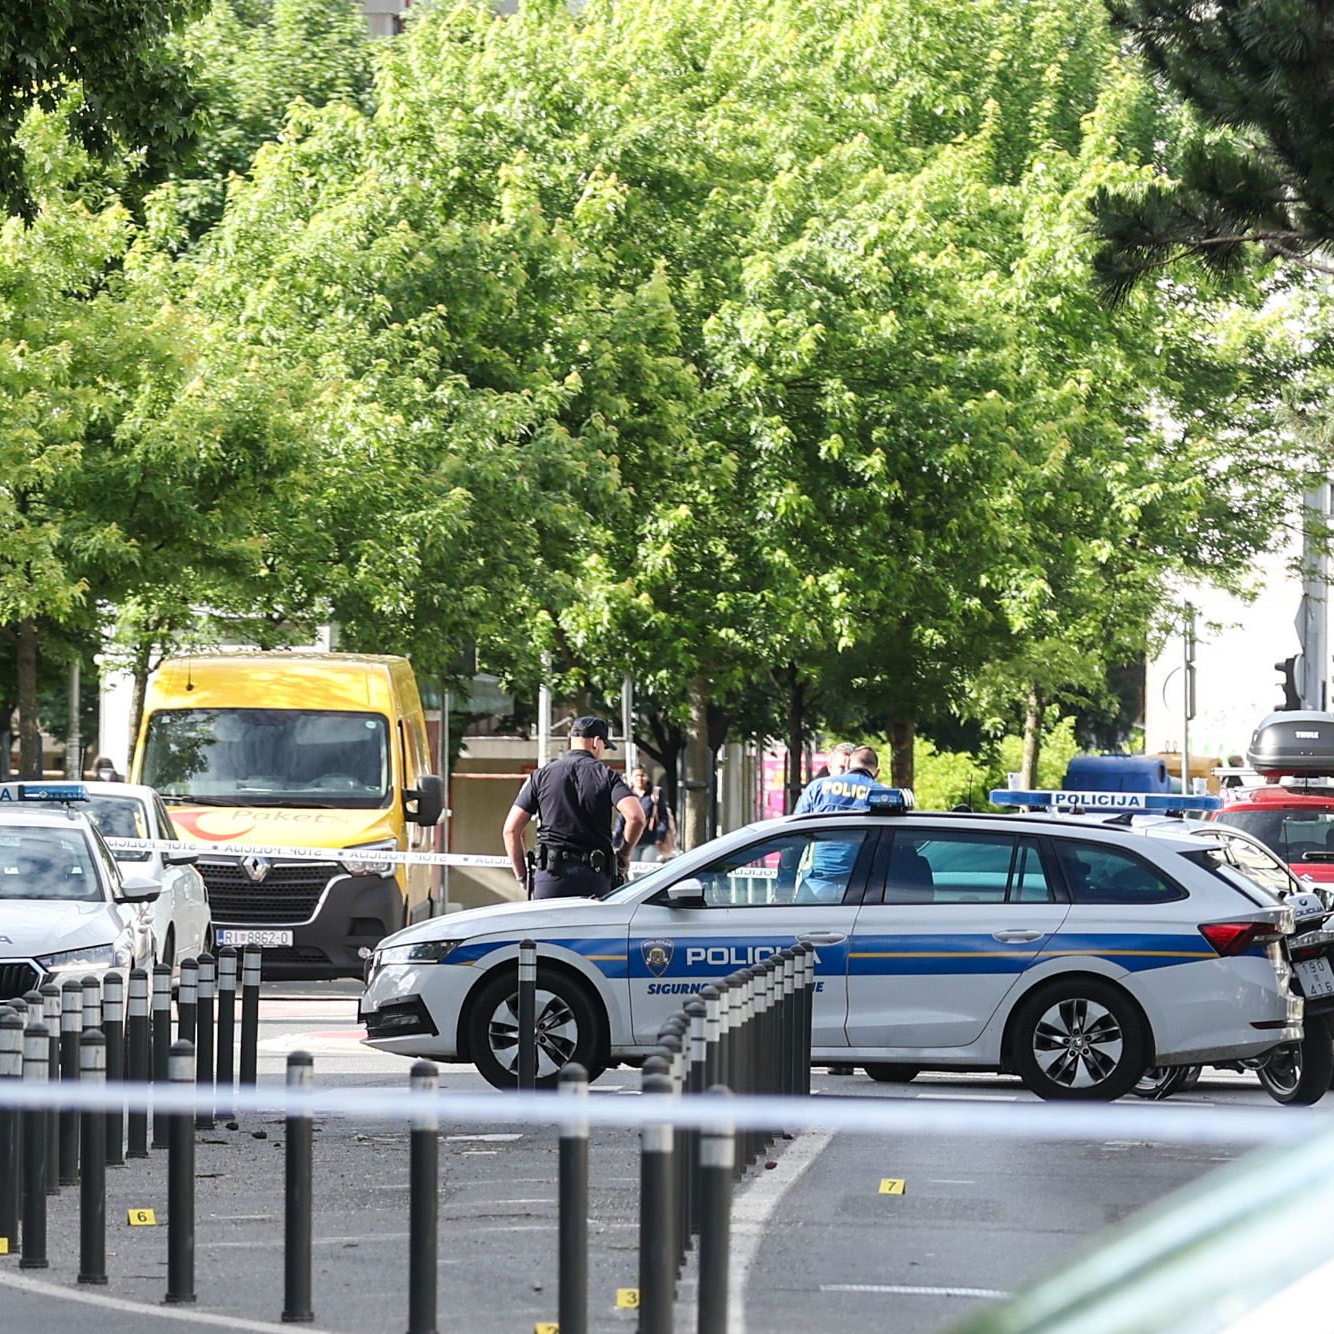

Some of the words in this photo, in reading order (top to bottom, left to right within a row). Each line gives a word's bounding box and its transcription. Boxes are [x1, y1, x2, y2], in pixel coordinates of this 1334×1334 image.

[1055, 794, 1140, 808] POLICIJA
[225, 932, 238, 944] RI
[1302, 961, 1325, 975] 190
[1310, 981, 1333, 995] 416
[887, 1181, 897, 1192] 7
[137, 1212, 147, 1222] 6
[627, 1292, 638, 1304] 3
